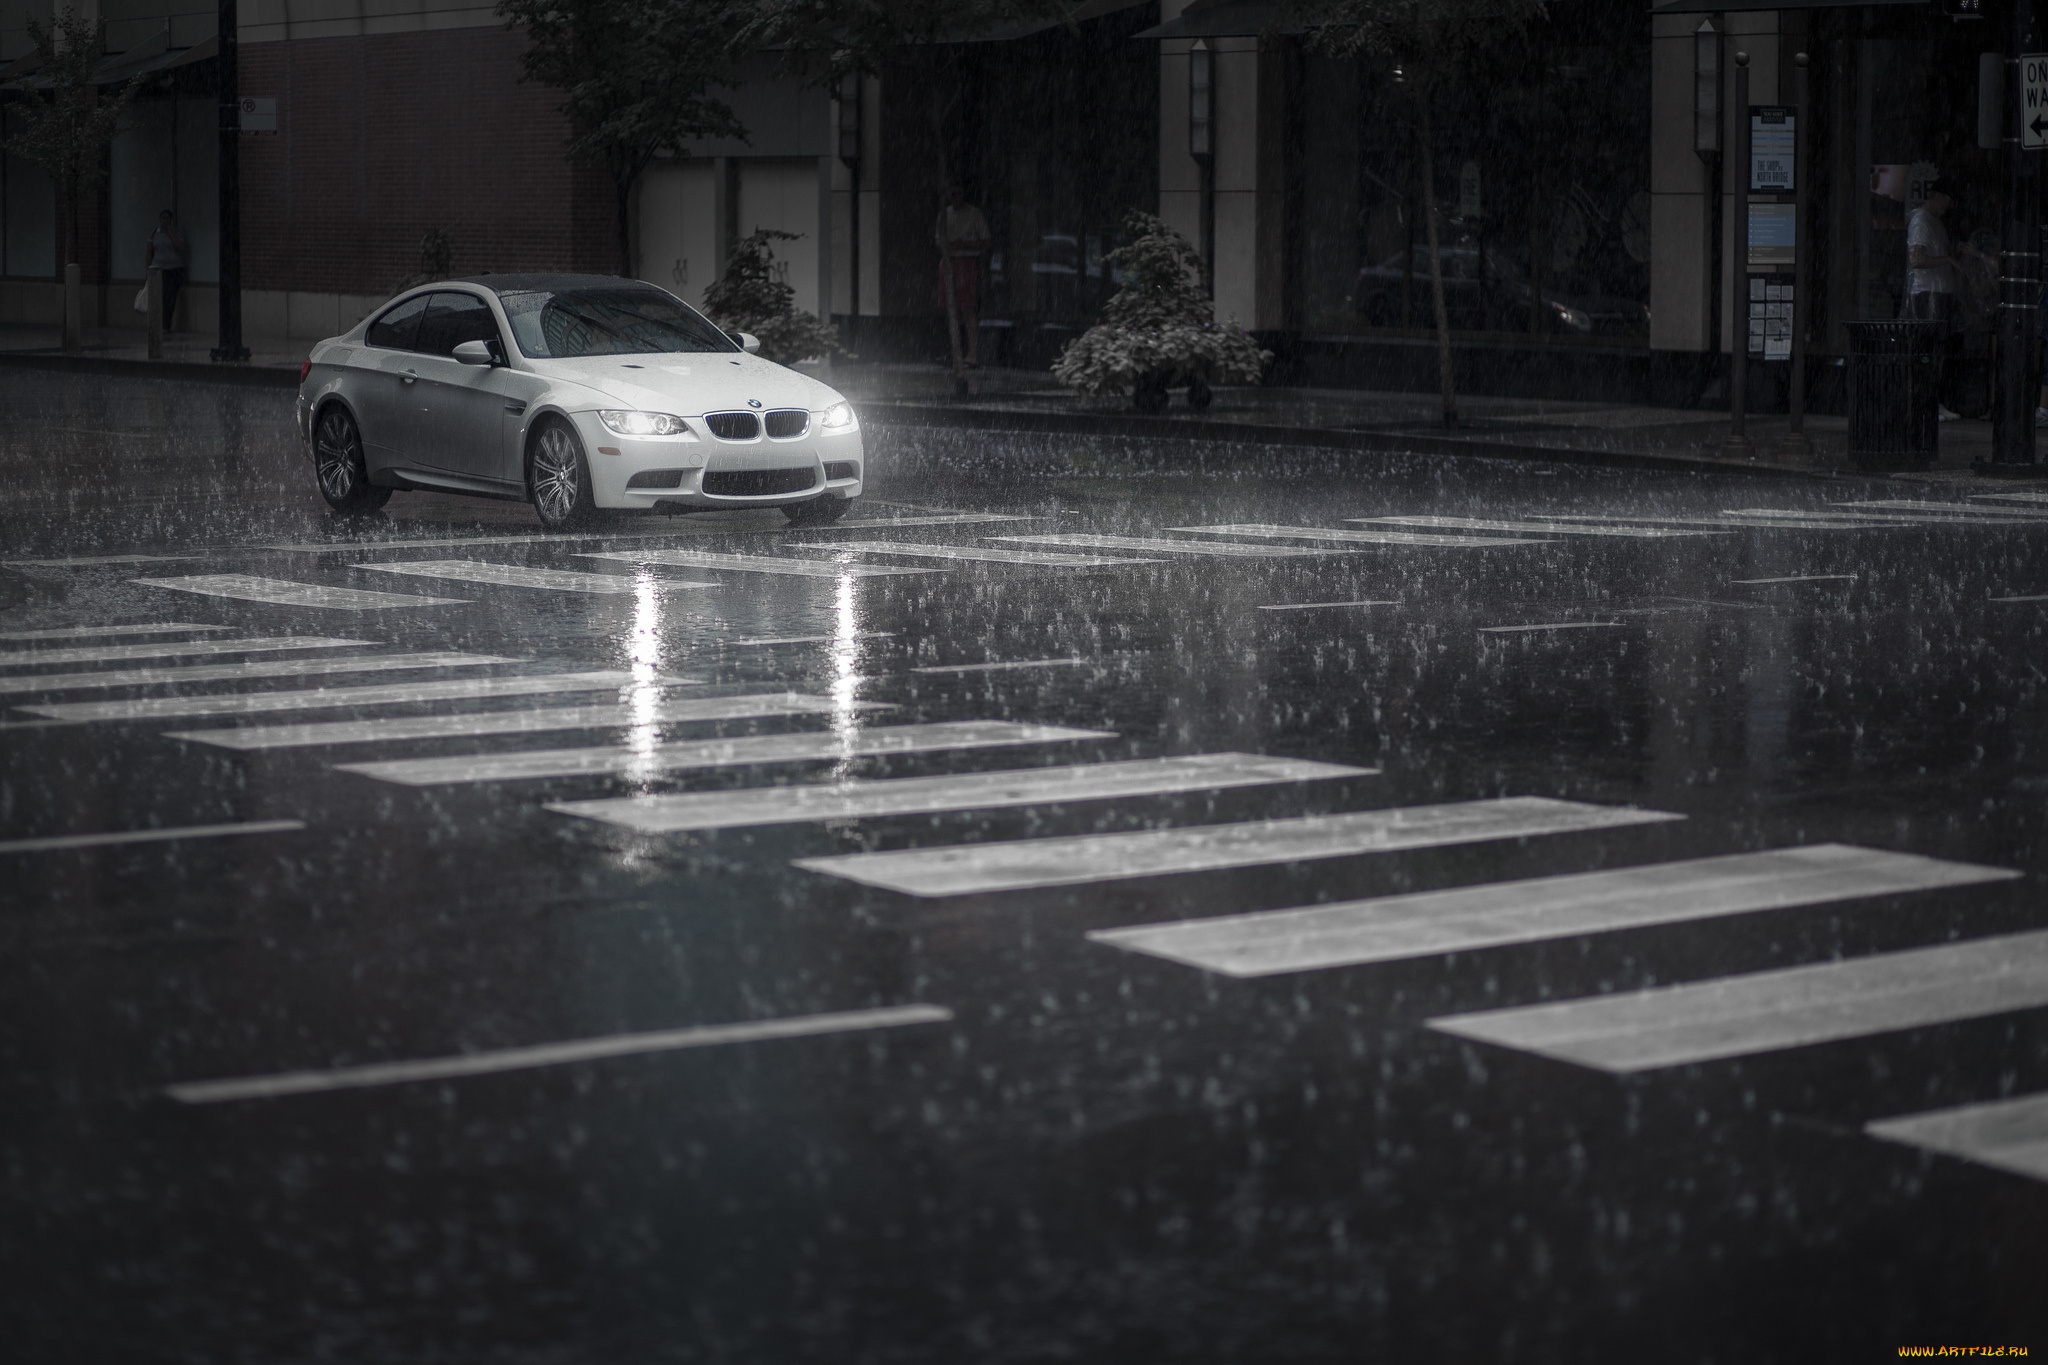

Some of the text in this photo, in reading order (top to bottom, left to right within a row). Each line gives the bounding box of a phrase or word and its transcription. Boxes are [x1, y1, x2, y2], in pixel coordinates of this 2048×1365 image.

[2027, 62, 2048, 83] ON
[2027, 87, 2048, 108] WA
[1757, 160, 1766, 171] THE
[1766, 160, 1781, 172] SHOPS
[1757, 171, 1789, 183] NORTH BRIDGE
